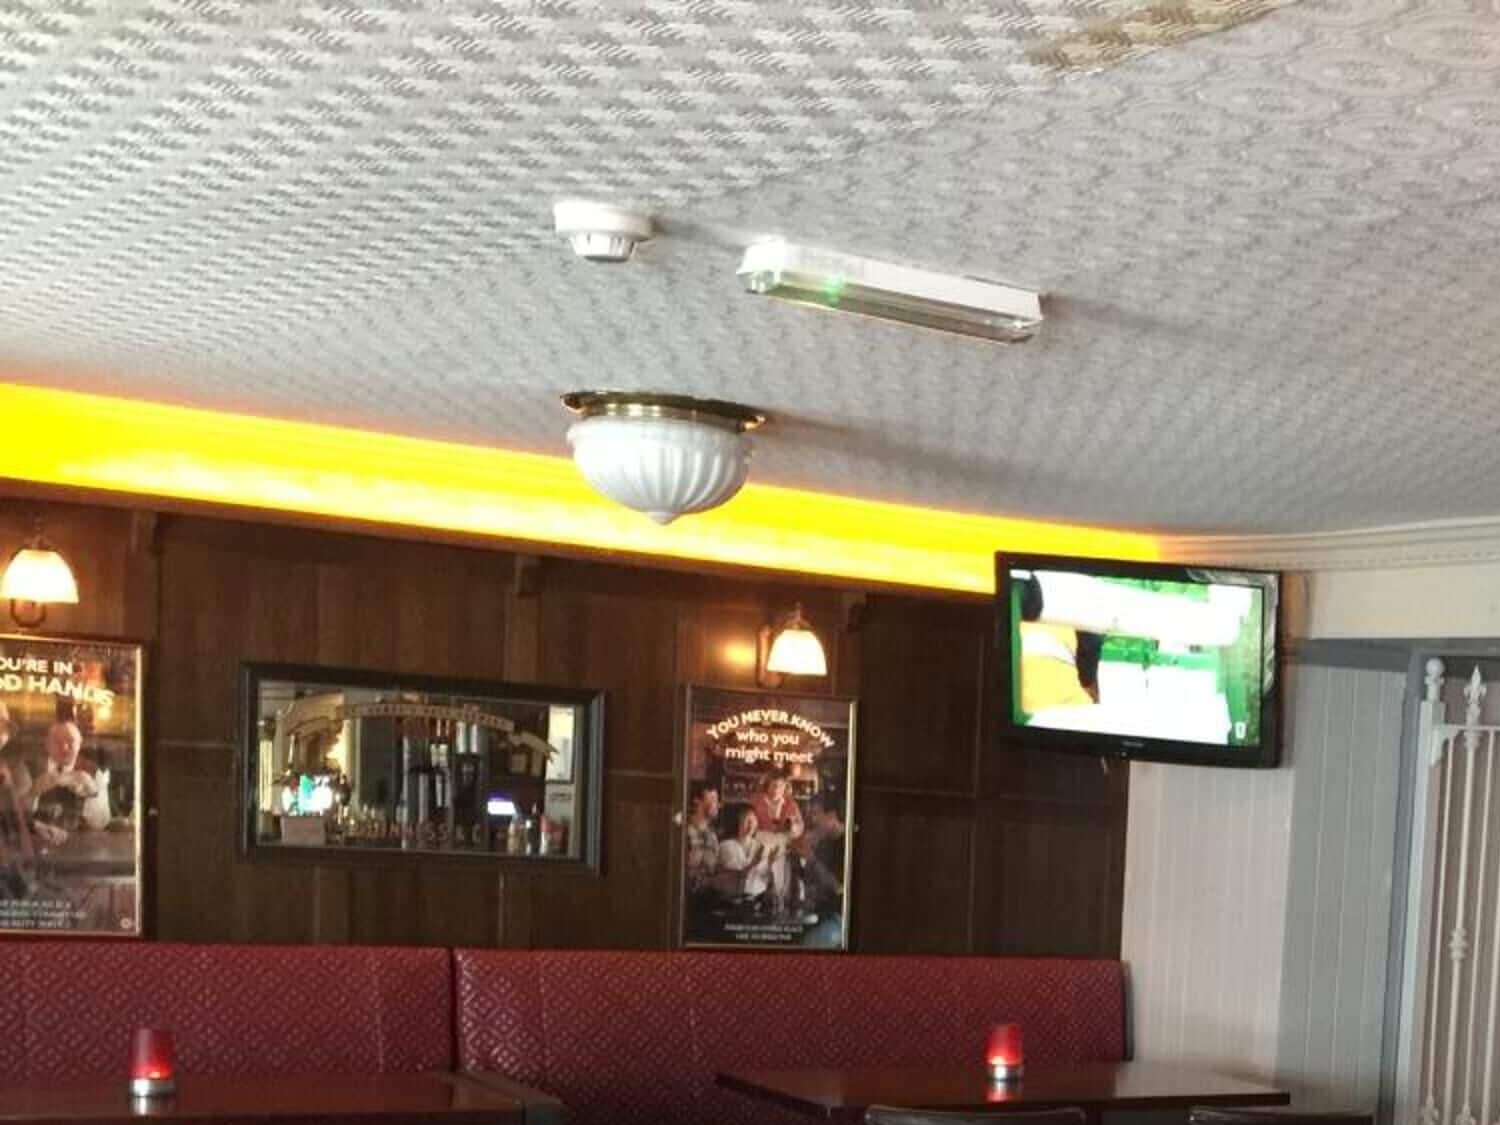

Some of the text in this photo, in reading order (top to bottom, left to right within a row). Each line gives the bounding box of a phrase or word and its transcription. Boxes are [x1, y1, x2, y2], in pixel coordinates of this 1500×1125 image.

[53, 661, 73, 675] IN
[28, 675, 115, 707] HANDS
[706, 709, 836, 748] YOU NEVER KNOW
[735, 728, 800, 748] who you
[725, 745, 814, 764] might meet
